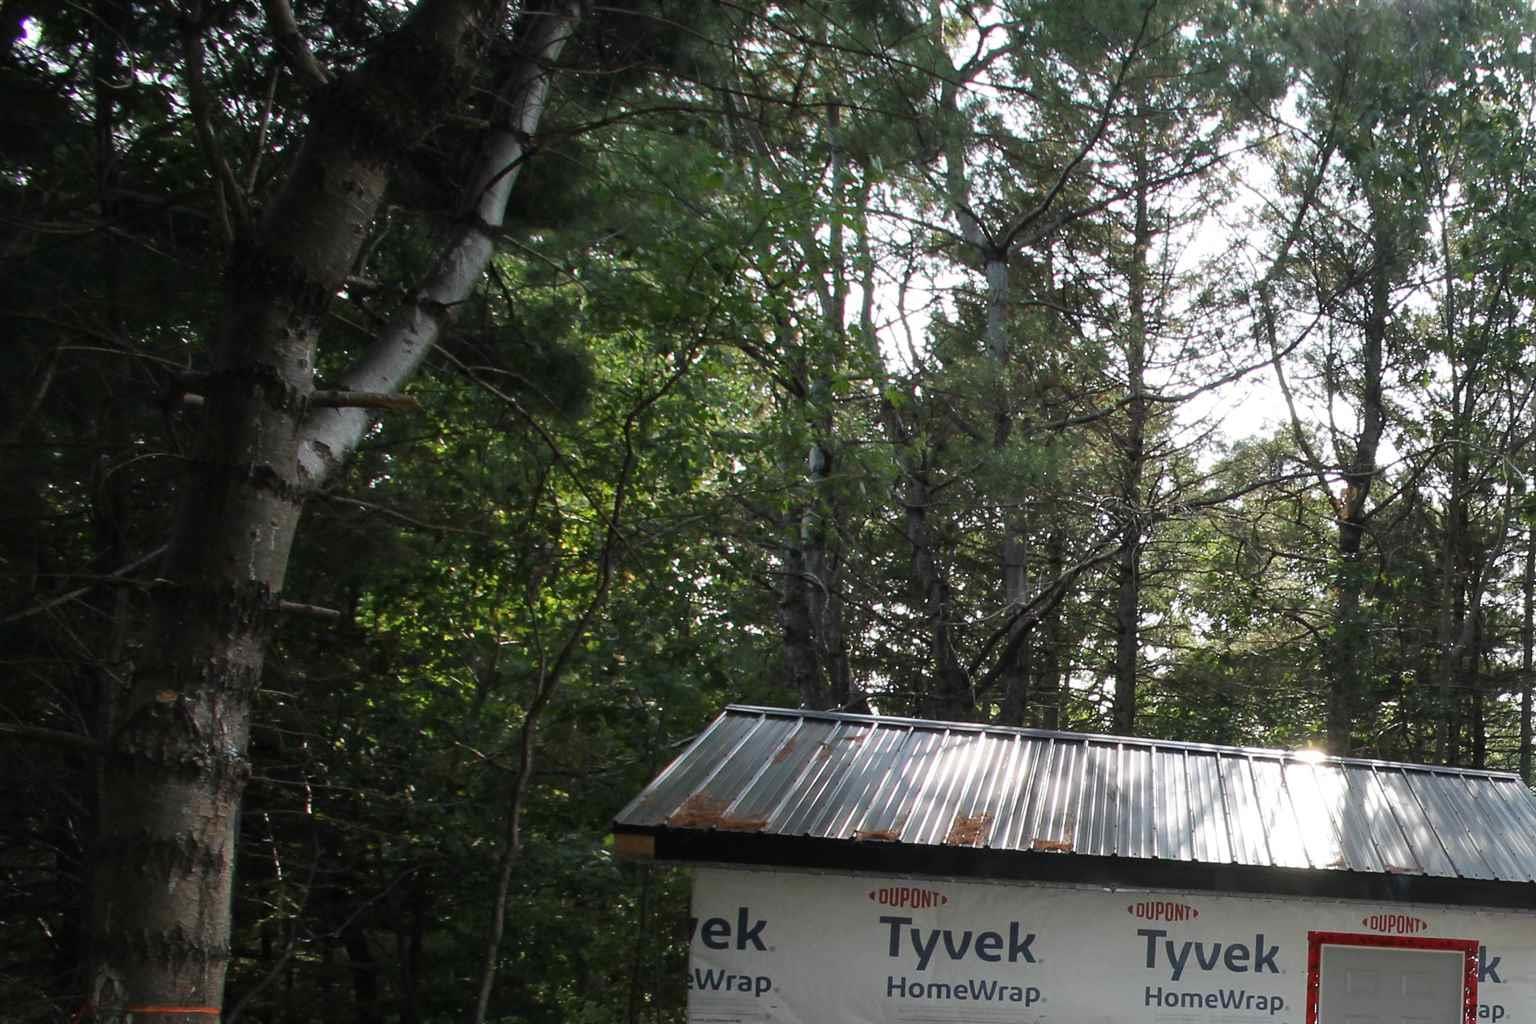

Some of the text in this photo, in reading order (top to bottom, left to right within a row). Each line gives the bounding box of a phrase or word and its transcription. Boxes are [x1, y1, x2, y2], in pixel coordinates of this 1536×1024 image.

[878, 887, 941, 909] DUPONT
[1136, 902, 1192, 922] DUPONT
[1370, 915, 1422, 934] DUPONT
[879, 916, 1037, 971] Tyvek
[1137, 929, 1281, 981] Tyvek
[887, 976, 1041, 1007] HomeWrap
[1144, 986, 1285, 1015] HomeWrap
